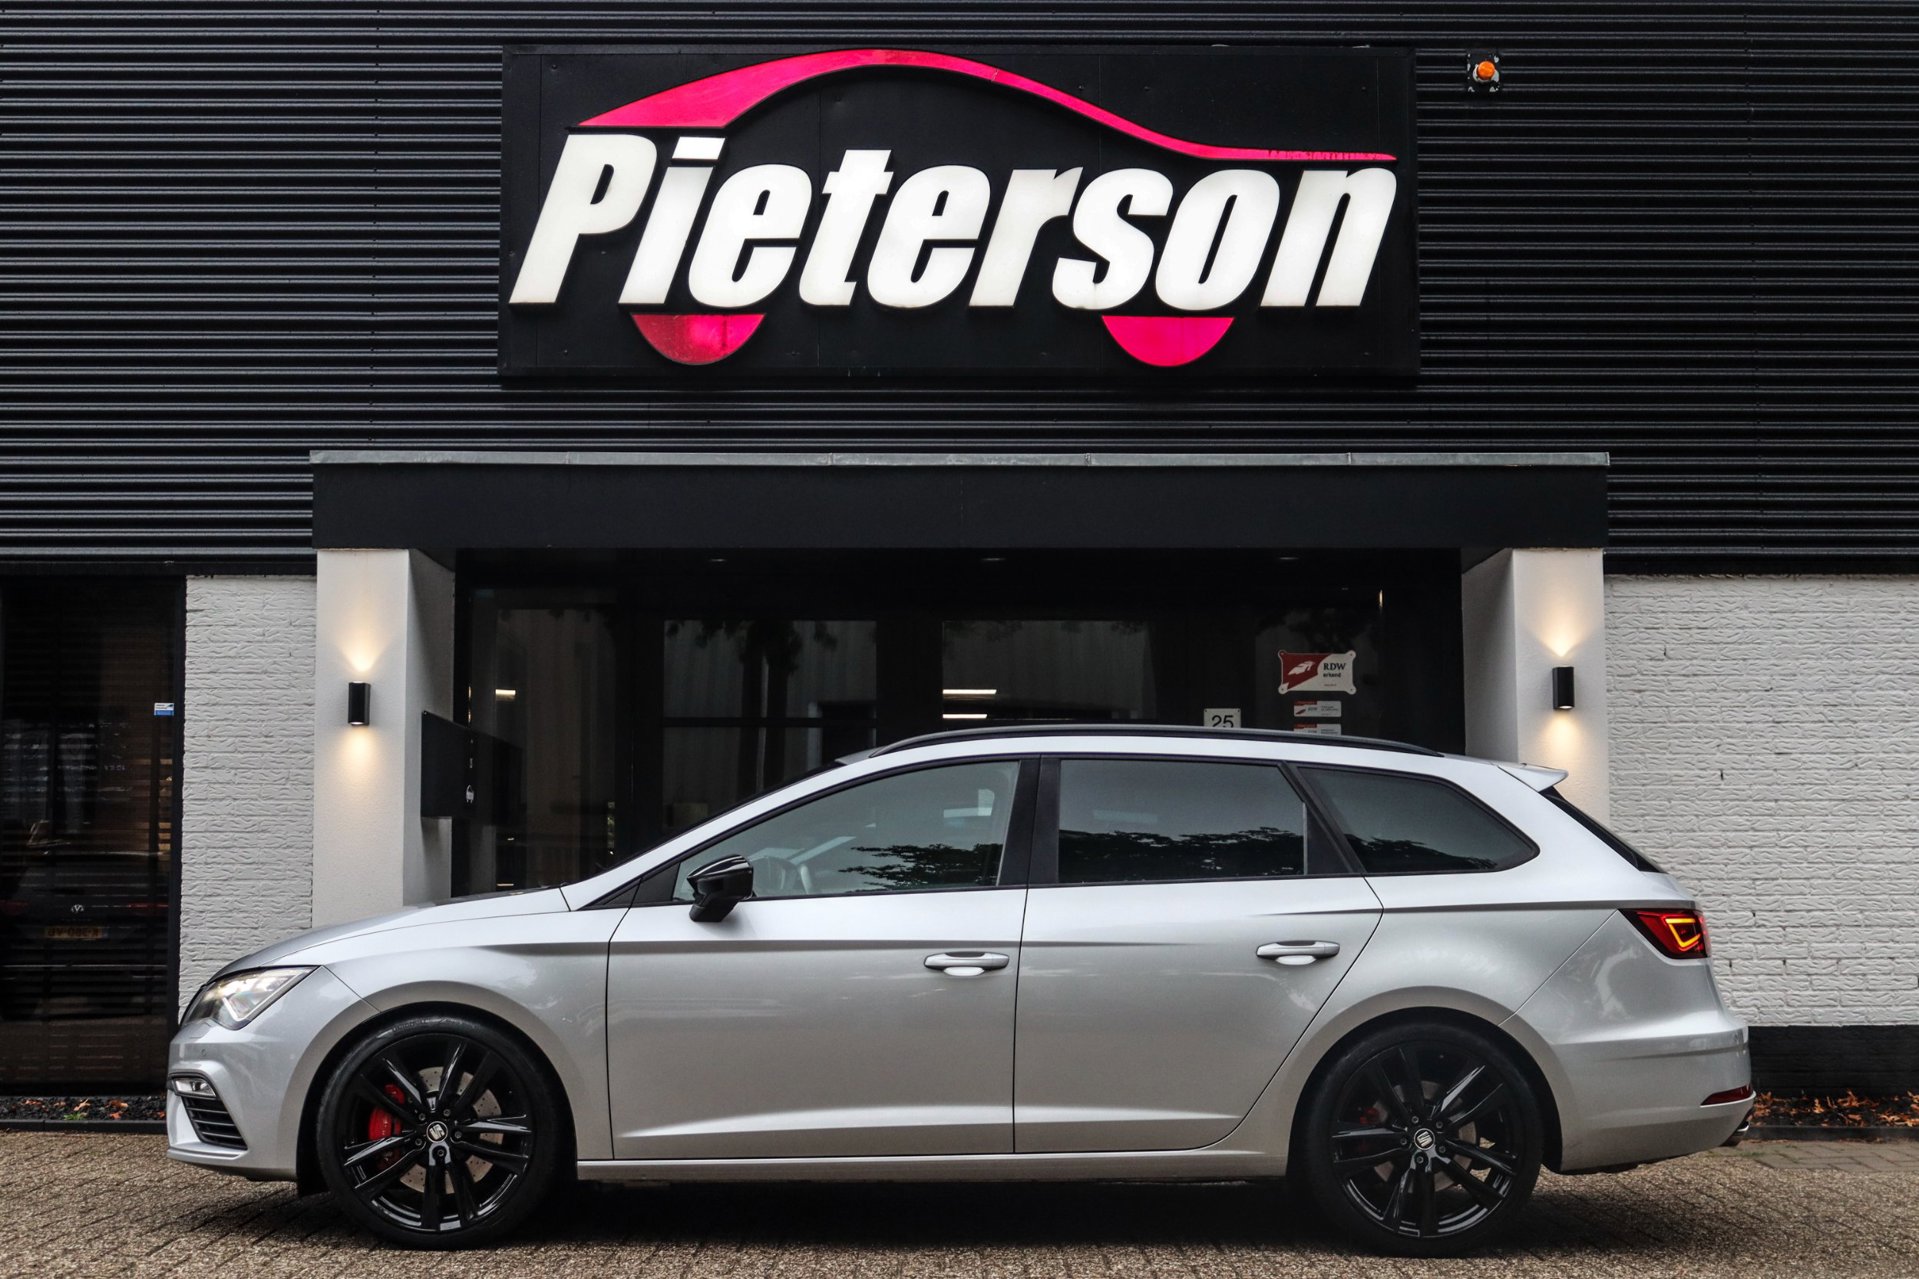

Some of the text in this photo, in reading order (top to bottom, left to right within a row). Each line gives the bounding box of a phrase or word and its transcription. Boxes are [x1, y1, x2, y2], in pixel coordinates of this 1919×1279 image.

[508, 134, 1397, 310] Pieterson
[1323, 662, 1346, 671] RDW
[1211, 714, 1234, 728] 25
